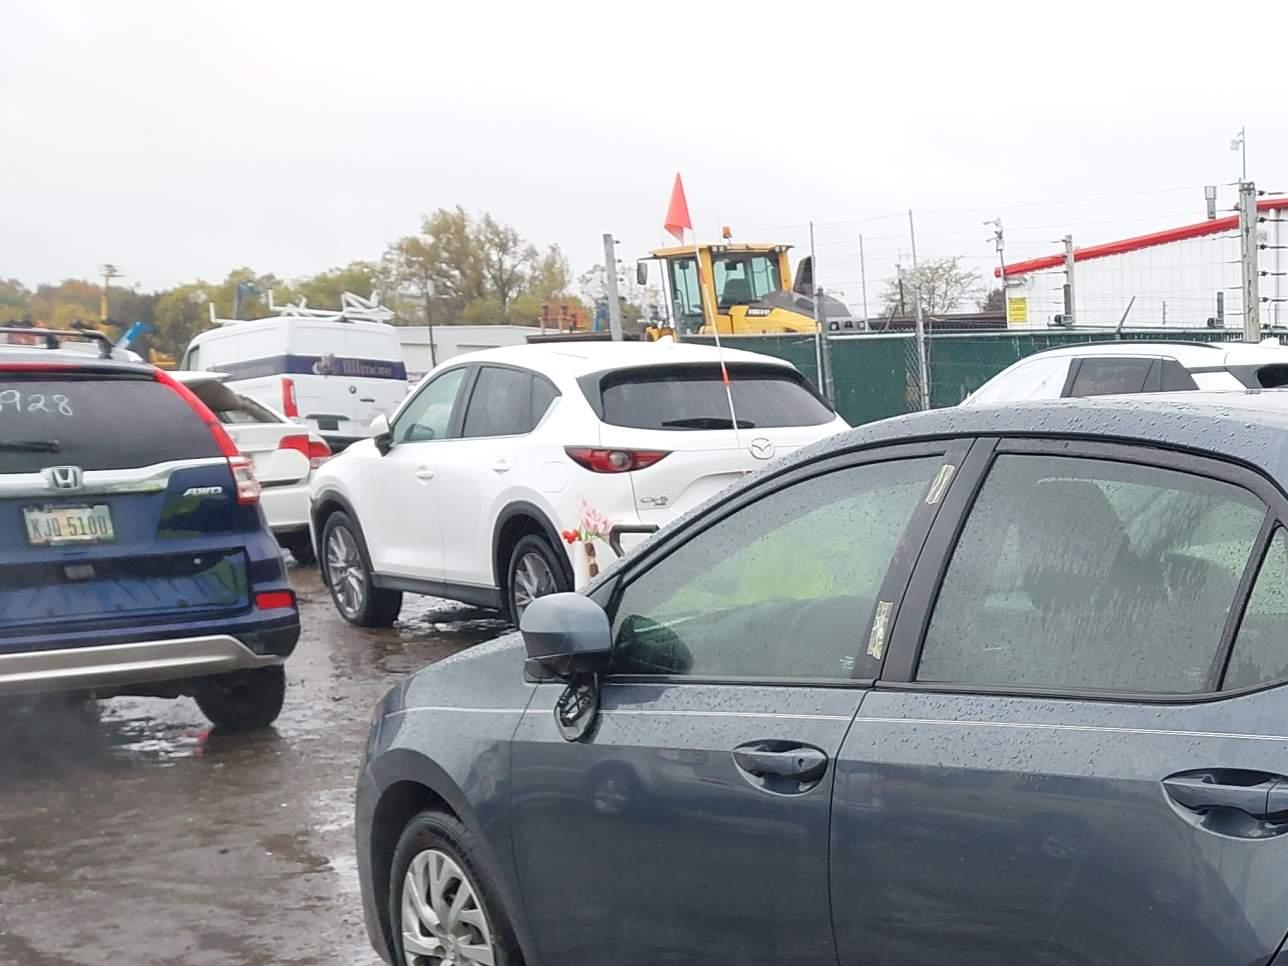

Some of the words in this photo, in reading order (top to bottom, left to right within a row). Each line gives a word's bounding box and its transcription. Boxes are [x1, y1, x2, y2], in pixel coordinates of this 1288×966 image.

[0, 389, 73, 416] 928
[182, 486, 223, 497] AWD
[66, 515, 108, 537] 5100
